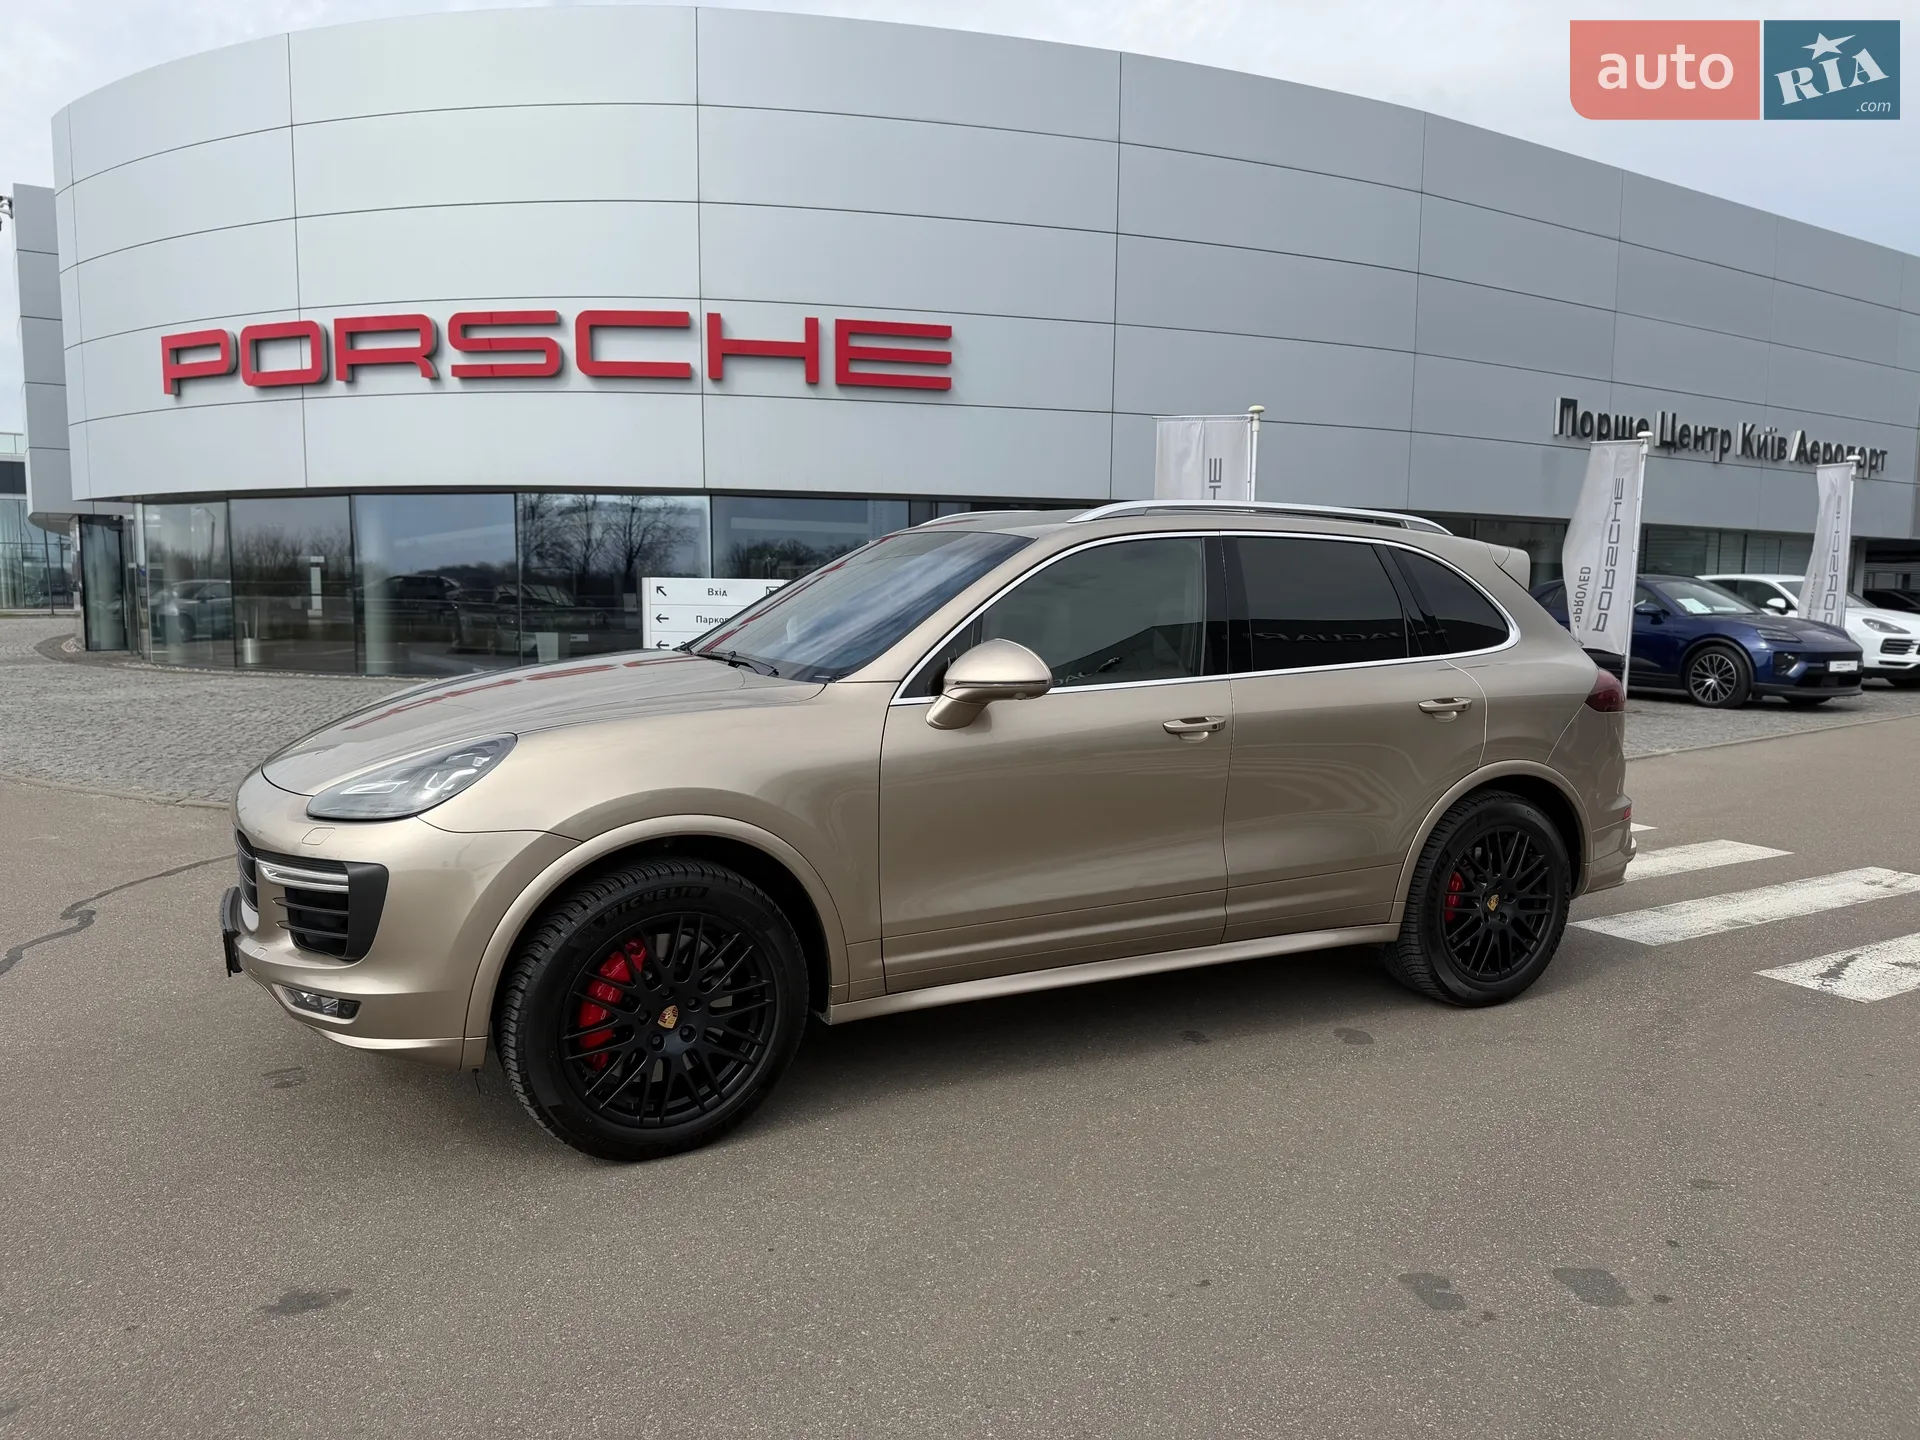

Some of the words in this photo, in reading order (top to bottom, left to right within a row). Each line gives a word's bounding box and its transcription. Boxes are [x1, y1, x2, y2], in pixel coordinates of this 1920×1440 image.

[161, 310, 952, 395] PORSCHE
[1655, 410, 1731, 462] Центр
[1735, 422, 1788, 461] Київ
[708, 588, 728, 597] Вхід
